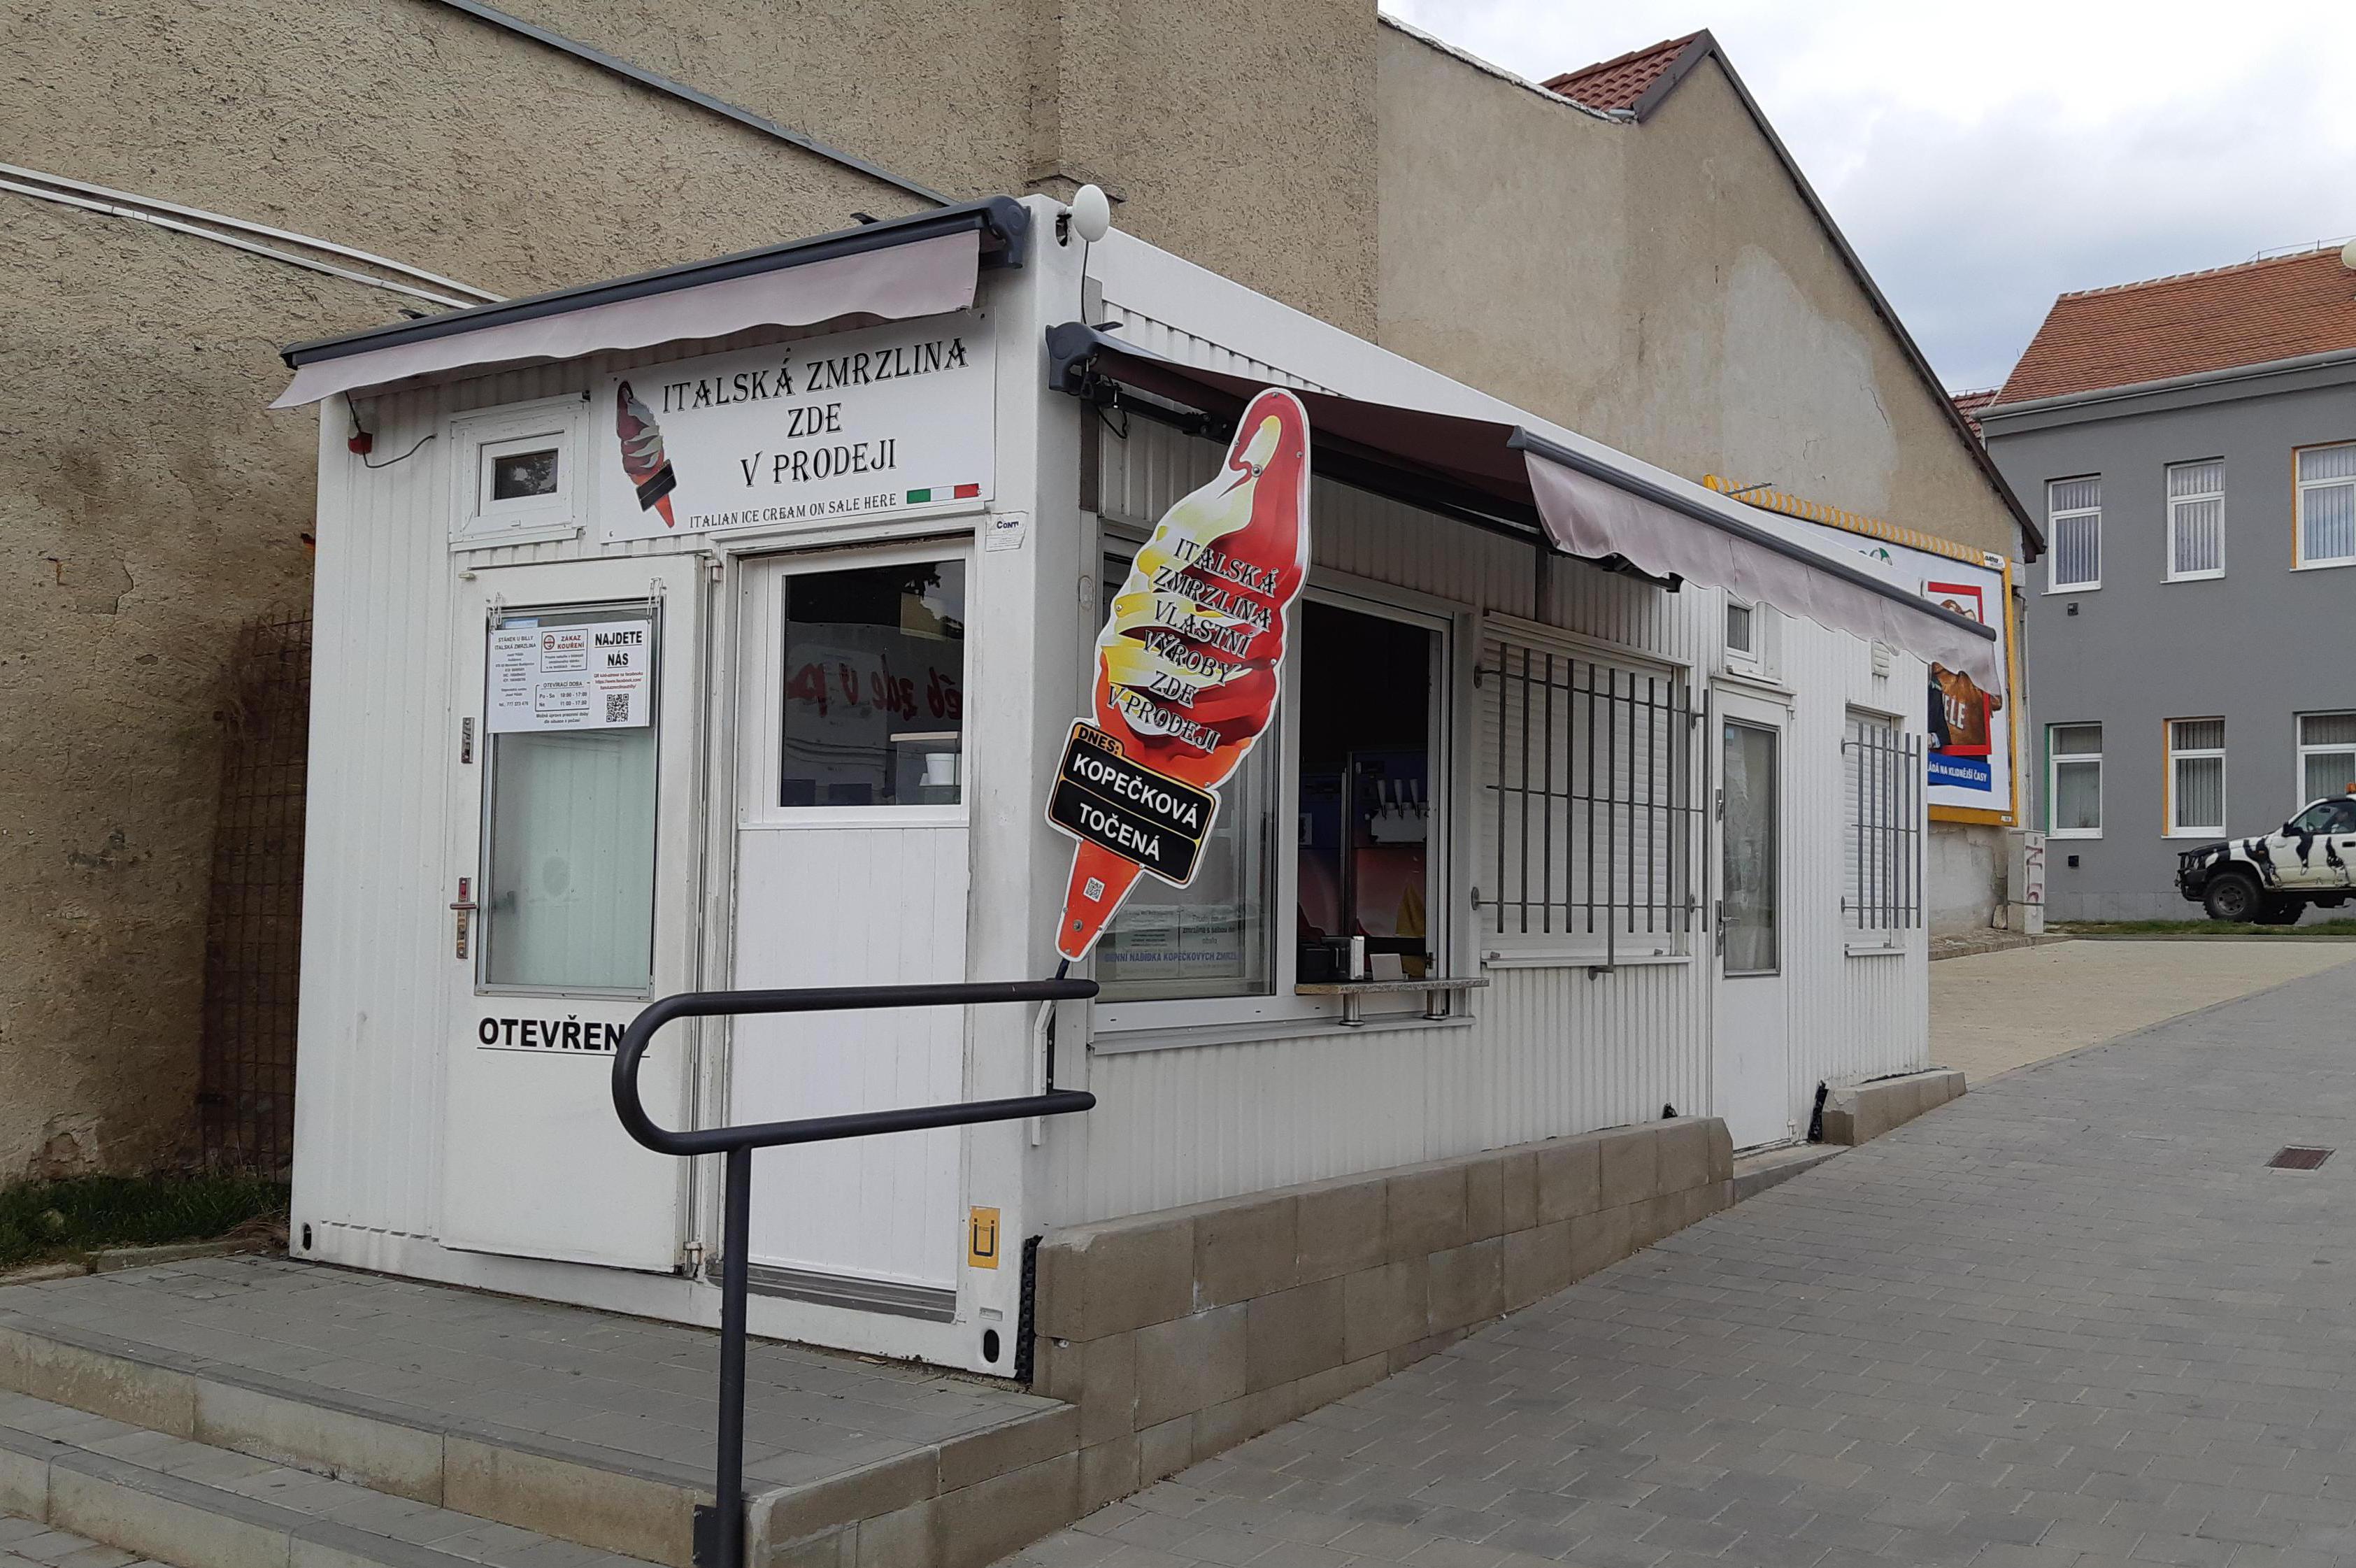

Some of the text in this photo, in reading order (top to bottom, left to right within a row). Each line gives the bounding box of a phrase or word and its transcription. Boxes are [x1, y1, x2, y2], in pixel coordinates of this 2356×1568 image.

[663, 338, 968, 413] ITALSKÁ ZMRZLINA
[787, 403, 843, 438] ZDE
[741, 439, 896, 487] V PRODEJI
[690, 493, 897, 528] ITALIAN ICE CREAM ON SALE HERE
[1173, 538, 1277, 597] ITALSKÁ
[1154, 565, 1271, 629] ZMRZLINA
[595, 631, 643, 646] NAJDETE
[1154, 599, 1252, 657] VLASTNÍ
[607, 650, 629, 667] NÁS
[1143, 630, 1239, 686] VÝROBY
[1150, 670, 1197, 708] ZDE
[1108, 685, 1221, 753] V PRODEJI
[1942, 692, 1966, 730] ELE
[1078, 727, 1120, 755] DNES:
[1927, 761, 1987, 782] ÁDÁ NA KLIDNĚJŠÍ ČASY
[1073, 753, 1198, 829] KOPEČKOVÁ
[1079, 803, 1159, 861] TOČENÁ
[1164, 950, 1214, 962] KOPEČKOVÝCH
[478, 1014, 649, 1051] OTEVŘEN
